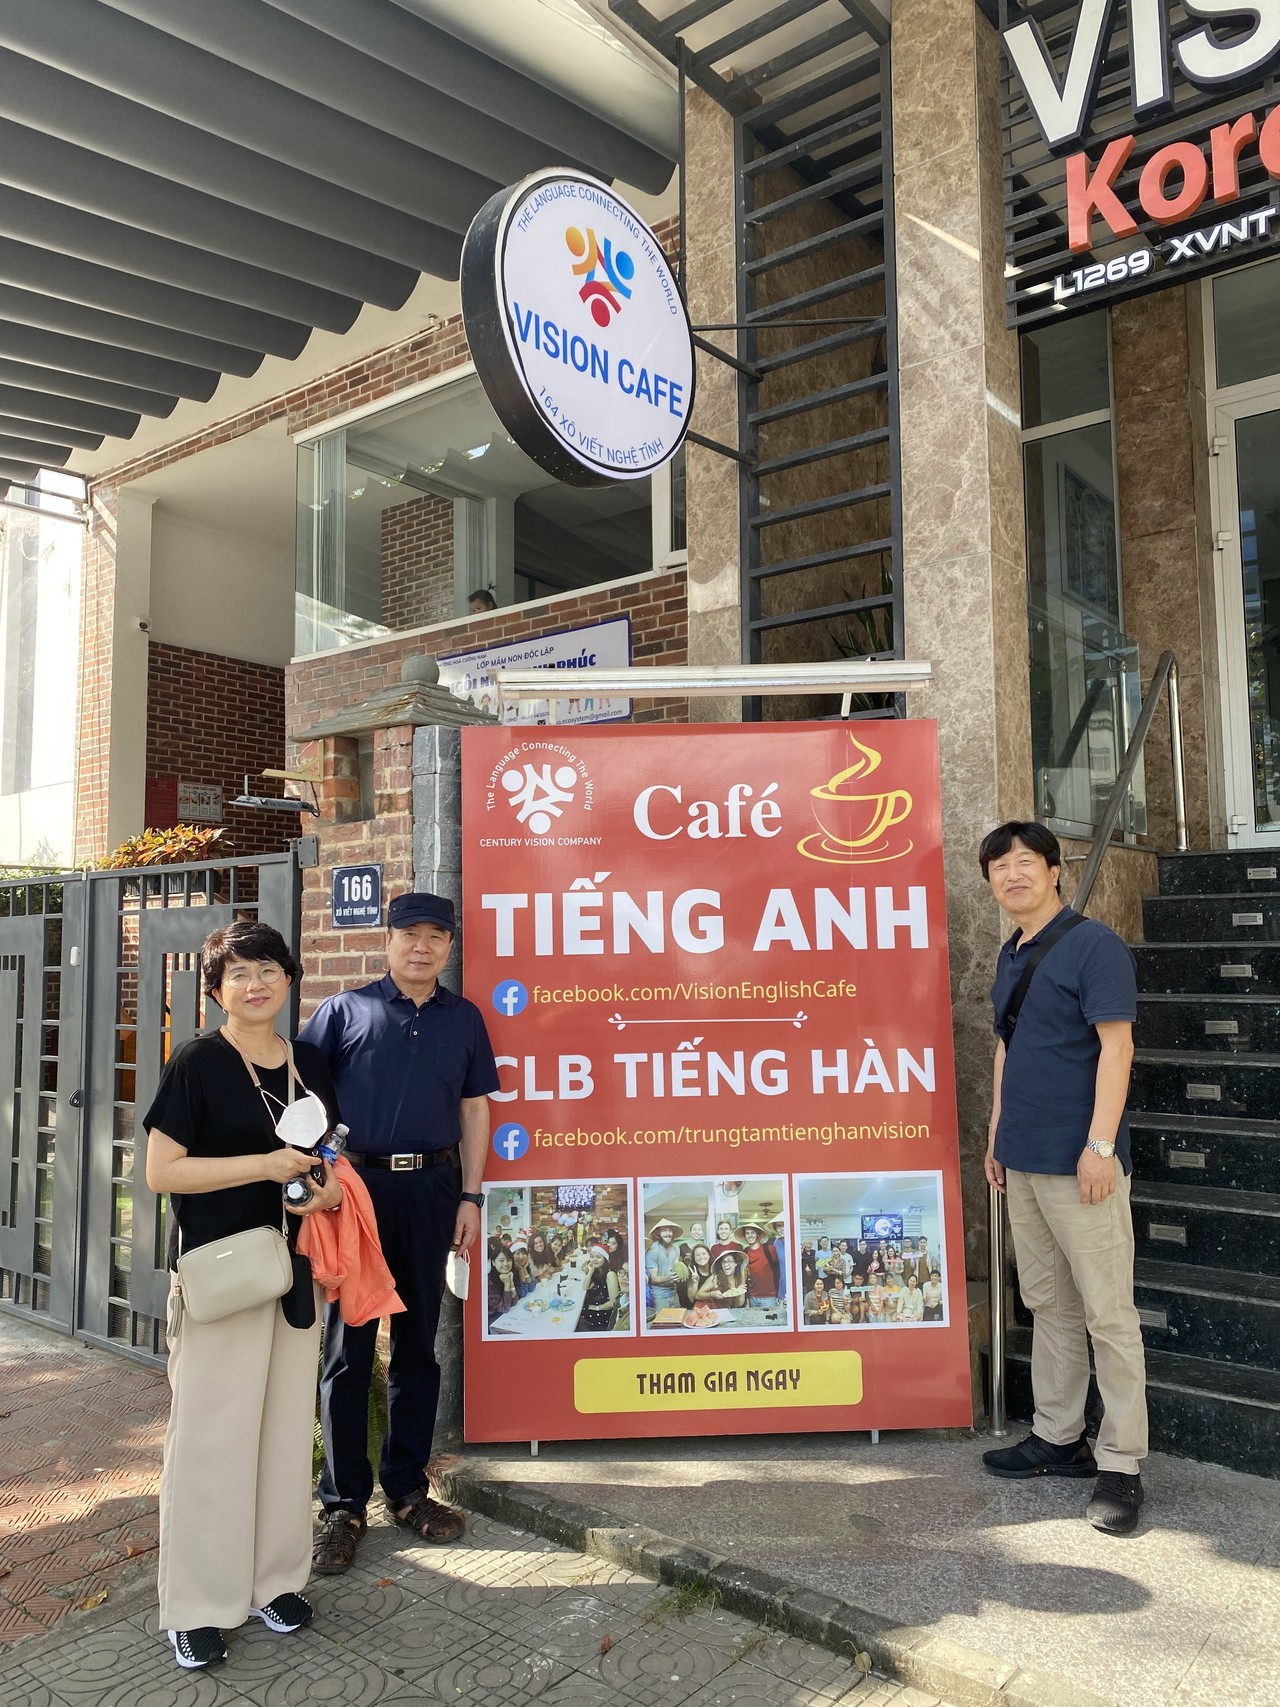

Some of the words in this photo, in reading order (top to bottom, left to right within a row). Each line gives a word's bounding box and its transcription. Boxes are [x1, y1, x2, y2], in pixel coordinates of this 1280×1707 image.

[517, 204, 534, 232] THE
[532, 184, 577, 214] LANGUAGE
[578, 186, 640, 239] CONNECTING
[640, 236, 658, 265] THE
[656, 265, 678, 315] WORLD
[1054, 249, 1151, 301] L1269
[1169, 207, 1276, 262] XVNT
[513, 301, 609, 385] VISION
[617, 359, 683, 418] CAFE
[540, 385, 559, 417] 164
[559, 413, 576, 437] XÔ
[579, 431, 604, 457] VIẾT
[606, 446, 639, 466] NGHỆ
[638, 437, 664, 459] TĨNH
[507, 654, 523, 663] NON
[521, 742, 577, 763] Connecting
[486, 748, 520, 789] Language
[575, 759, 589, 778] The
[486, 792, 496, 811] The
[583, 780, 595, 811] World
[633, 782, 783, 840] Café
[480, 838, 522, 847] CENTURY
[524, 837, 555, 847] VISION
[557, 836, 602, 846] COMPANY
[341, 874, 372, 902] 166
[481, 871, 725, 957] TIẾNG
[752, 885, 929, 951] ANH
[533, 980, 857, 1004] facebook.com/VisionEnglishCafe
[487, 1054, 595, 1103] CLB
[613, 1037, 789, 1099] TIẾNG
[811, 1038, 936, 1095] HÀN
[534, 1121, 930, 1148] facebook.com/trungtamtienghanvision
[636, 1372, 696, 1395] THAM
[703, 1371, 738, 1393] GIA
[746, 1369, 801, 1392] NGAY
